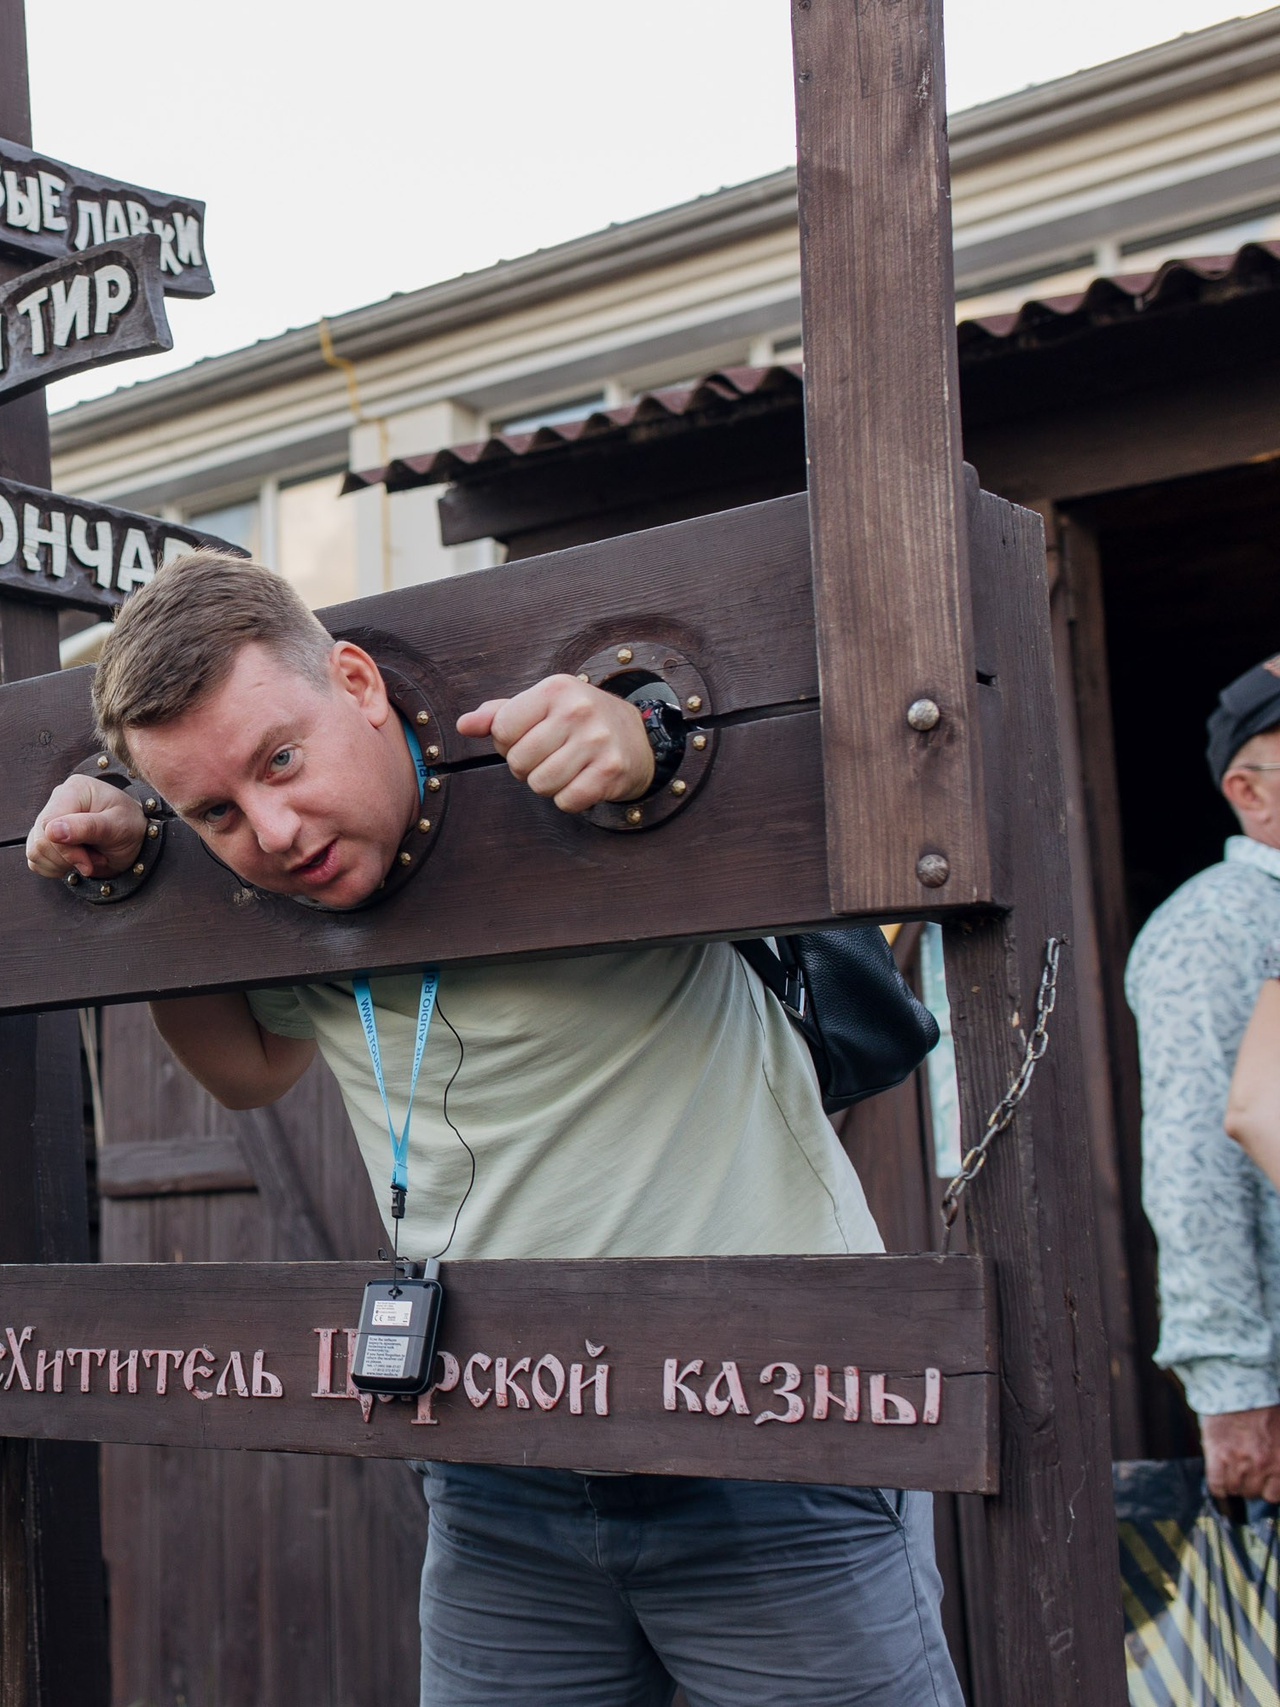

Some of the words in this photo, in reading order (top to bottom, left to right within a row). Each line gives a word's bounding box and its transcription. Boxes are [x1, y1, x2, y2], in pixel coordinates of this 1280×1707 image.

[74, 199, 202, 275] ЛАВКИ
[17, 264, 132, 355] ТИР
[311, 1327, 609, 1425] Црской
[663, 1358, 941, 1426] казны
